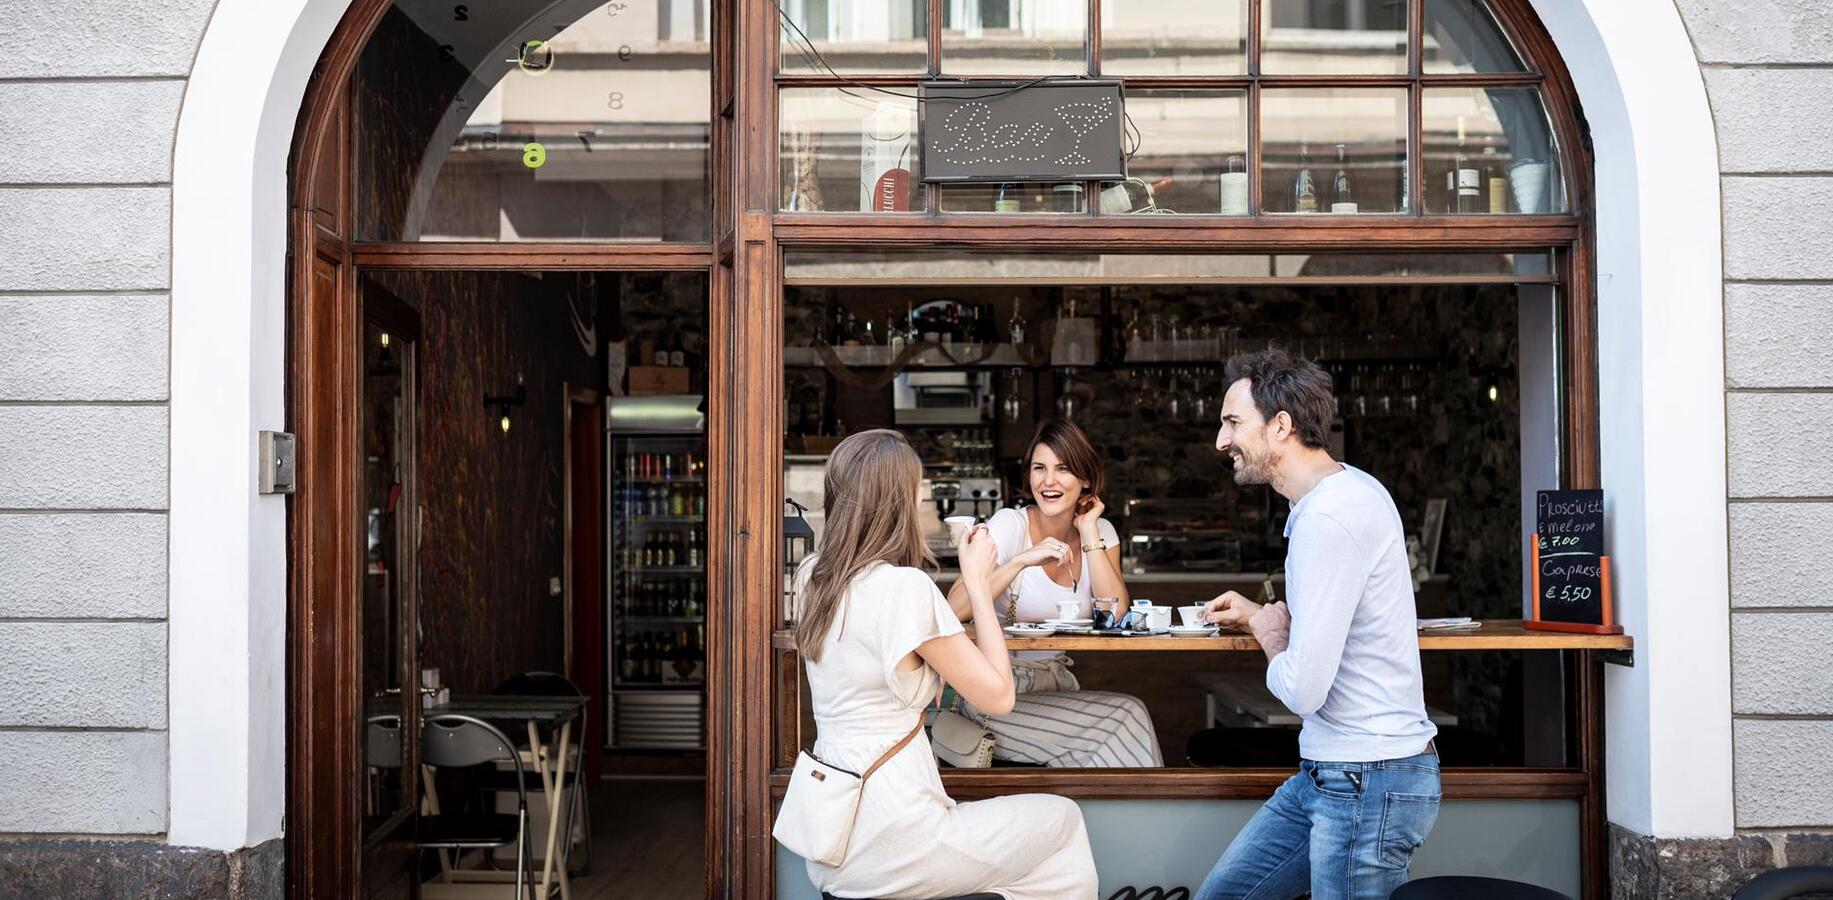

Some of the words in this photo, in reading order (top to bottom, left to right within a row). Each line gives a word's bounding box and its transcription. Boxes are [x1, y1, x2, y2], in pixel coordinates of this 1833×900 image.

[933, 102, 1053, 151] Bar
[883, 177, 894, 212] LUCCHI
[1538, 537, 1548, 549] €
[1545, 586, 1556, 598] €
[1560, 585, 1591, 601] 5,50
